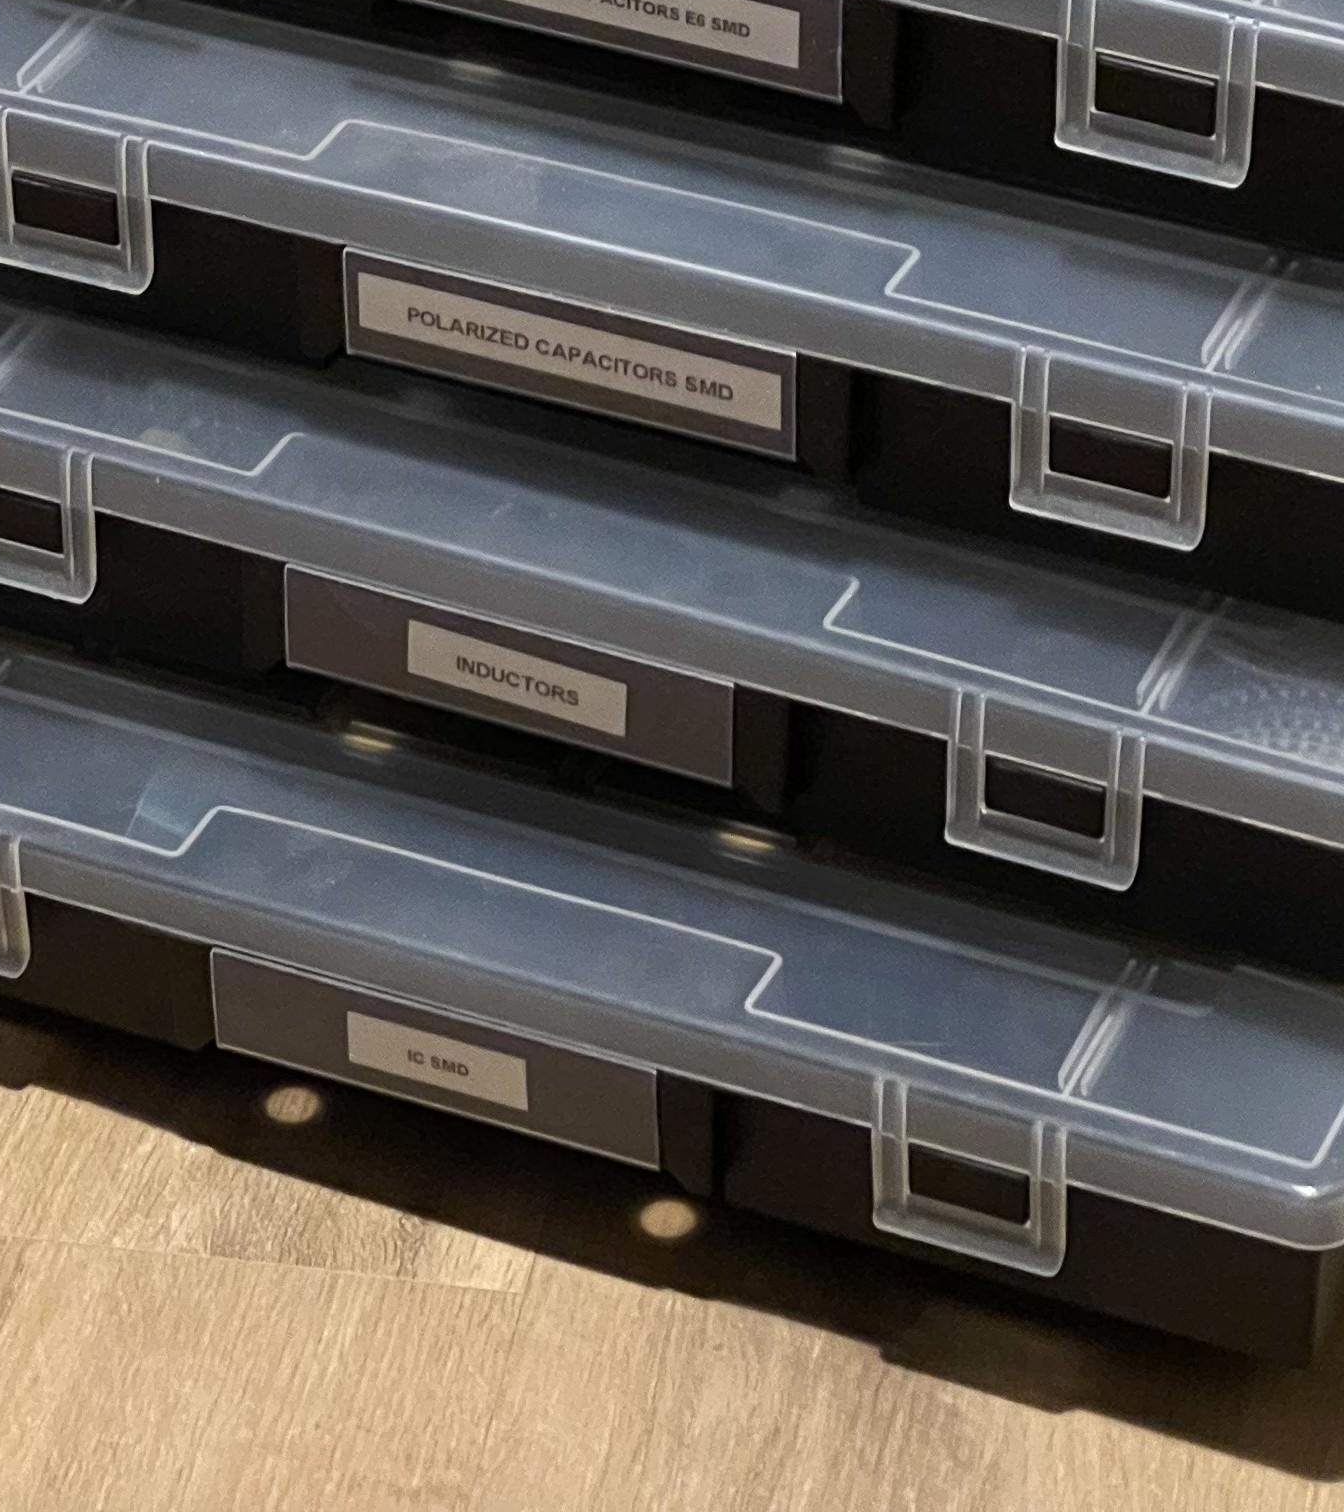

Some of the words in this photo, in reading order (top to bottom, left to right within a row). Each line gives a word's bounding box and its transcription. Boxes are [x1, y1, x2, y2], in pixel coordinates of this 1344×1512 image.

[685, 10, 706, 27] E6
[711, 18, 751, 38] SMD
[407, 306, 530, 351] POLARIZED
[535, 338, 678, 388] CAPACITORS
[684, 375, 734, 402] SMD
[456, 655, 580, 706] INDUCTORS
[407, 1049, 425, 1065] IC
[430, 1055, 469, 1077] SMD
